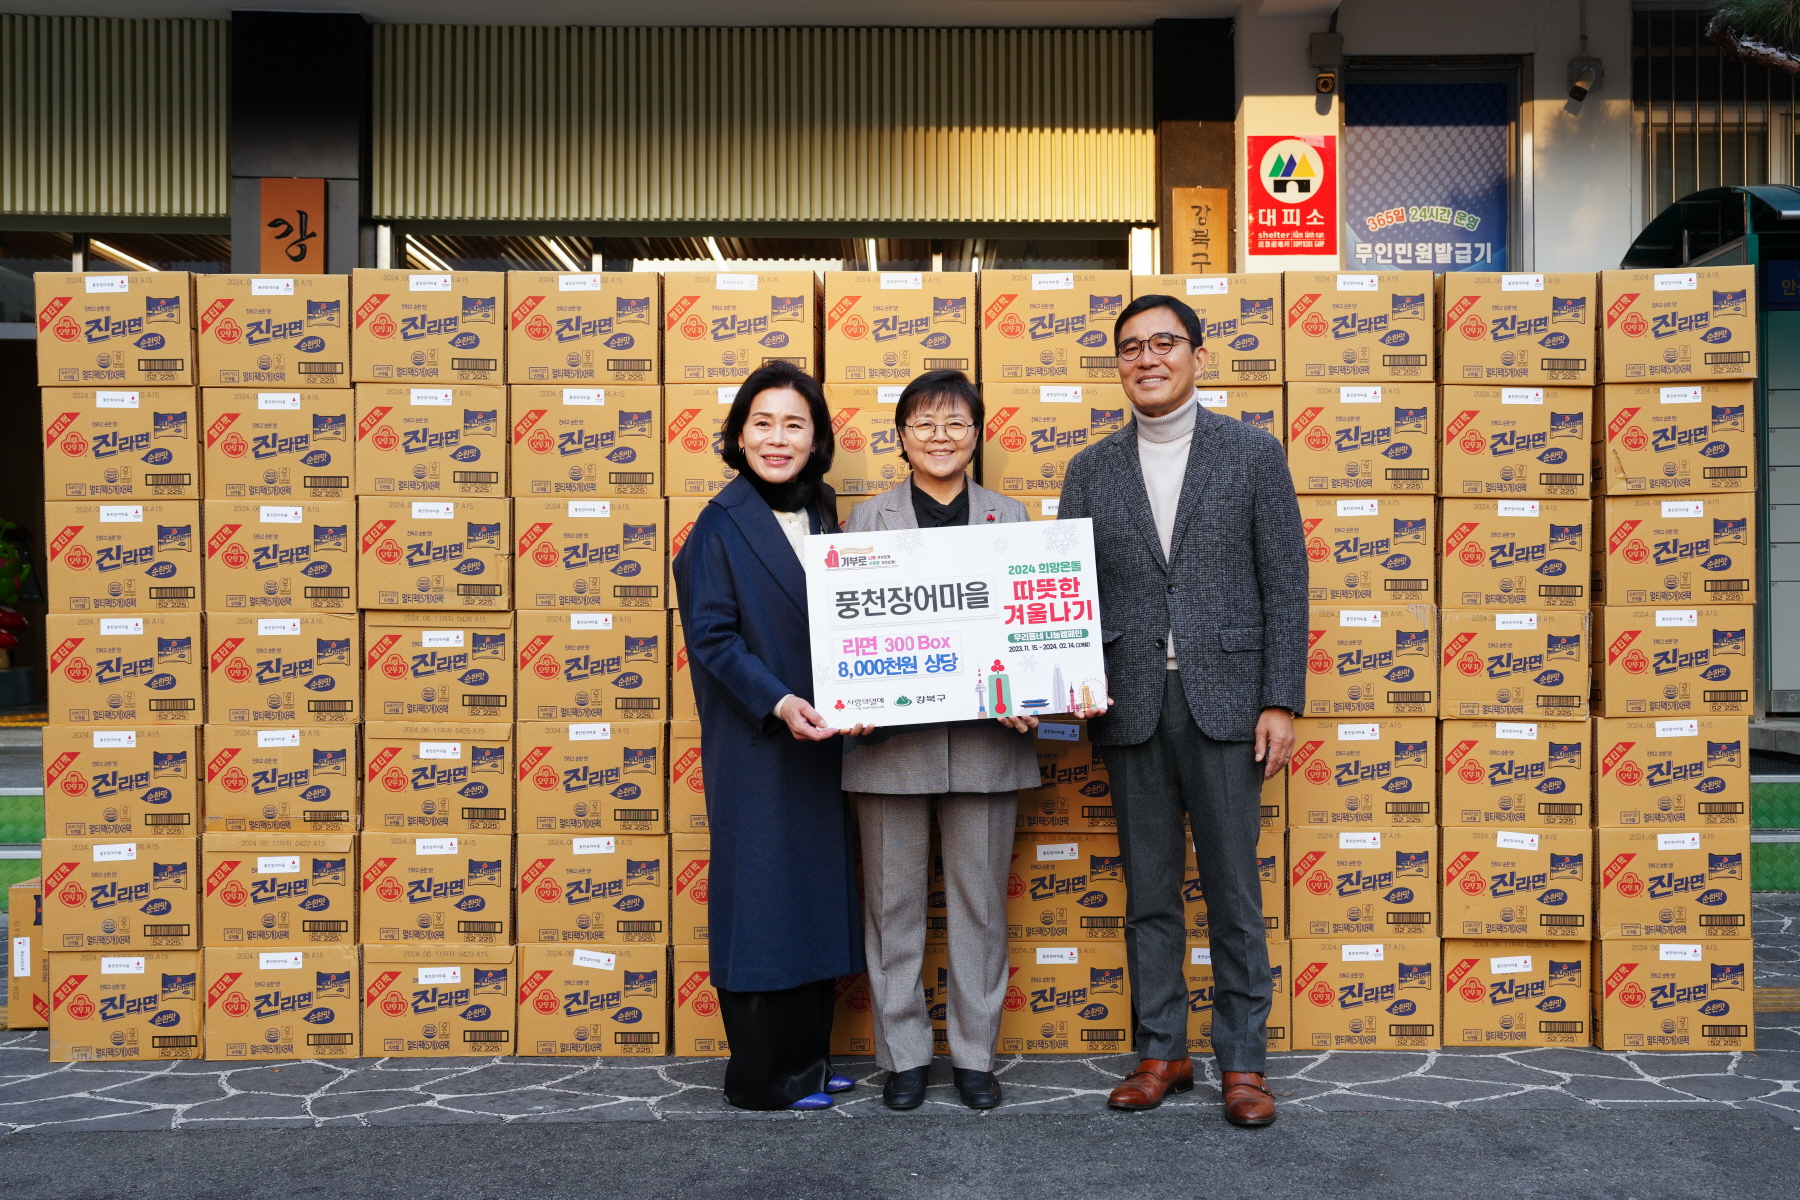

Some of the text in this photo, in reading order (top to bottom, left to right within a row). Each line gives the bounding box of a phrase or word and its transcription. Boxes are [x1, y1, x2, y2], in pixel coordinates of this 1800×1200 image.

[1258, 208, 1325, 226] 대피소
[1366, 206, 1480, 232] 365일 24시간 운영
[267, 210, 317, 262] 강
[1190, 204, 1212, 274] 강북구
[1355, 242, 1492, 264] 무인민원발급기
[358, 296, 381, 319] 멀티팩
[58, 328, 76, 337] 오뚜기
[85, 316, 144, 344] 진라면
[246, 318, 304, 346] 진라면
[400, 314, 458, 341] 진라면
[555, 315, 613, 342] 진라면
[711, 316, 769, 342] 진라면
[872, 315, 930, 341] 진라면
[1028, 312, 1086, 339] 진라면
[1332, 312, 1389, 340] 진라면
[1491, 315, 1549, 342] 진라면
[1625, 324, 1643, 333] 오뚜기
[1651, 311, 1710, 339] 진라면
[300, 338, 321, 351] 순한맛
[1545, 335, 1566, 347] 순한맛
[1449, 412, 1471, 435] 멀티팩
[92, 431, 151, 459] 진라면
[226, 444, 243, 452] 오뚜기
[252, 432, 309, 460] 진라면
[402, 427, 460, 454] 진라면
[532, 441, 550, 449] 오뚜기
[558, 429, 616, 456] 진라면
[1030, 425, 1088, 452] 진라면
[1334, 426, 1391, 453] 진라면
[1388, 445, 1408, 457] 순한맛
[1490, 430, 1547, 457] 진라면
[1652, 425, 1709, 453] 진라면
[457, 448, 477, 460] 순한맛
[96, 544, 155, 572] 진라면
[252, 544, 310, 570] 진라면
[406, 540, 464, 567] 진라면
[562, 542, 620, 569] 진라면
[840, 556, 868, 568] 기부로
[1334, 538, 1390, 564] 진라면
[1489, 542, 1546, 568] 진라면
[1653, 538, 1711, 565] 진라면
[152, 564, 172, 576] 순한맛
[617, 562, 637, 574] 순한맛
[1008, 560, 1082, 575] 2024 희망온돌
[836, 581, 989, 619] 풍천장어마을
[1013, 577, 1080, 600] 따뜻한
[1004, 600, 1092, 625] 겨울나기
[842, 635, 951, 657] 라면 300 Box
[1014, 629, 1082, 641] 우리동네 나눔캠페인
[213, 640, 235, 664] 멀티팩
[411, 652, 469, 678] 진라면
[1312, 661, 1329, 669] 오뚜기
[1337, 649, 1393, 676] 진라면
[1652, 648, 1710, 676] 진라면
[96, 657, 155, 684] 진라면
[256, 657, 314, 684] 진라면
[564, 655, 622, 681] 진라면
[838, 653, 958, 679] 8,000천원 상당
[1487, 652, 1544, 679] 진라면
[1706, 667, 1726, 680] 순한맛
[846, 698, 884, 707] 사랑의열매
[916, 694, 946, 704] 강북구
[92, 770, 150, 798] 진라면
[252, 768, 310, 794] 진라면
[411, 764, 468, 791] 진라면
[563, 766, 620, 792] 진라면
[1034, 764, 1089, 791] 진라면
[1309, 772, 1326, 780] 오뚜기
[1335, 760, 1392, 787] 진라면
[1488, 760, 1546, 786] 진라면
[1542, 780, 1562, 792] 순한맛
[1646, 760, 1704, 787] 진라면
[65, 783, 83, 792] 오뚜기
[307, 787, 327, 799] 순한맛
[1295, 853, 1317, 876] 멀티팩
[90, 882, 150, 909] 진라면
[250, 878, 309, 905] 진라면
[407, 877, 465, 904] 진라면
[565, 878, 623, 905] 진라면
[1030, 874, 1086, 901] 진라면
[1336, 870, 1393, 897] 진라면
[1490, 871, 1547, 898] 진라면
[1621, 884, 1639, 892] 오뚜기
[1647, 872, 1706, 899] 진라면
[620, 897, 640, 910] 순한맛
[1543, 891, 1564, 903] 순한맛
[522, 973, 544, 996] 멀티팩
[1338, 982, 1396, 1009] 진라면
[1489, 978, 1546, 1005] 진라면
[1650, 982, 1708, 1009] 진라면
[99, 994, 158, 1021] 진라면
[227, 1004, 245, 1012] 오뚜기
[253, 991, 313, 1019] 진라면
[411, 988, 470, 1016] 진라면
[564, 990, 621, 1016] 진라면
[1030, 986, 1087, 1014] 진라면
[1392, 1002, 1412, 1014] 순한맛
